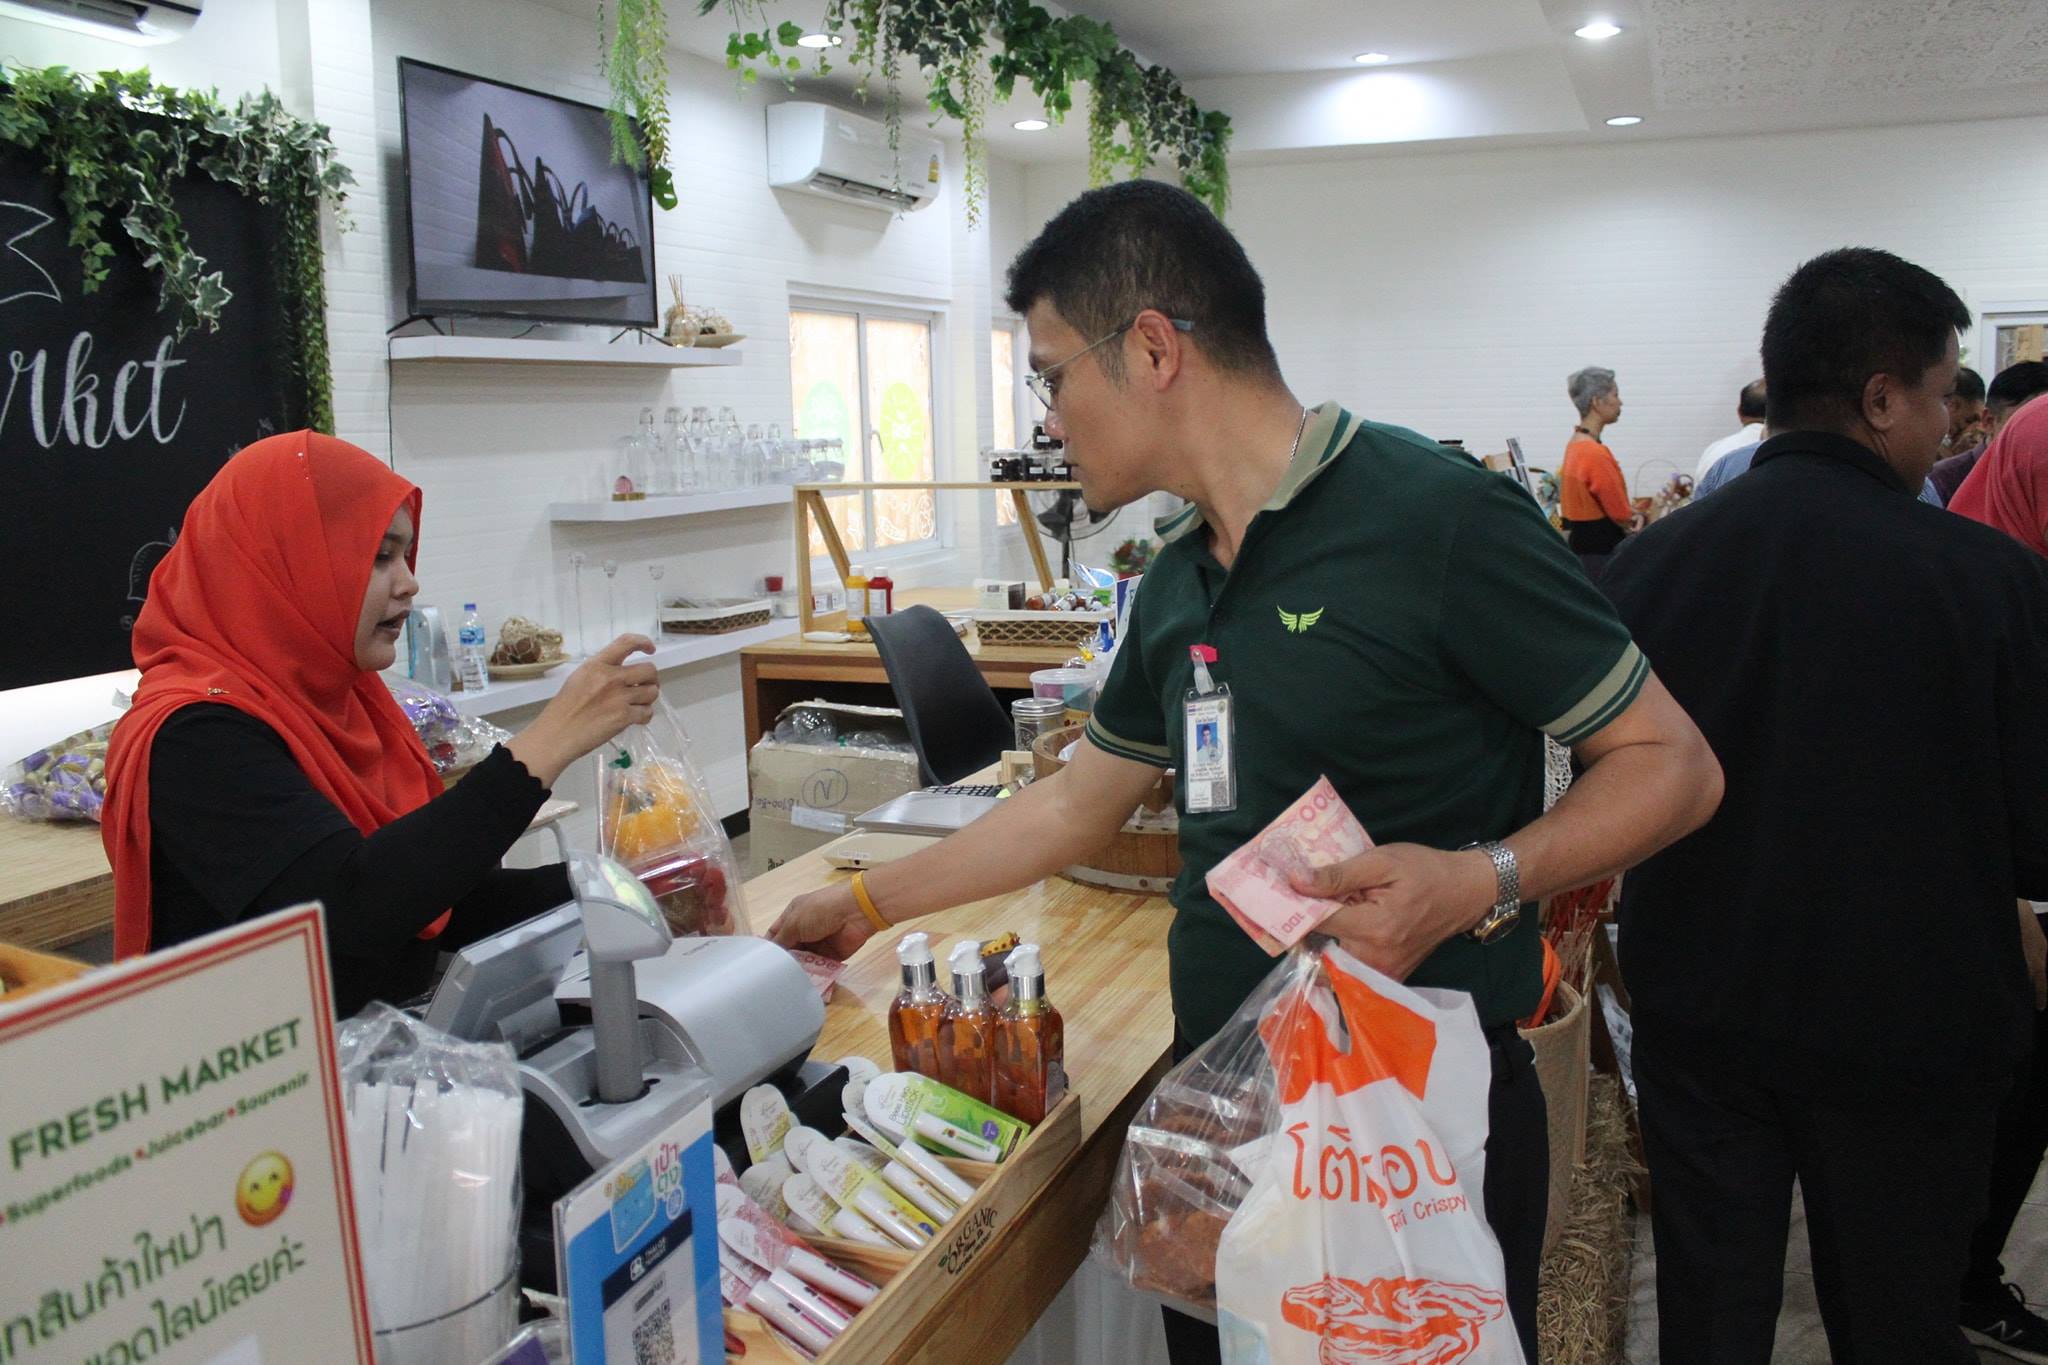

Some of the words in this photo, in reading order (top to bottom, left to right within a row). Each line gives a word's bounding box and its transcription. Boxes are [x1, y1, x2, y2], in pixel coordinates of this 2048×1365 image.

[8, 1083, 149, 1171] FRESH
[158, 1018, 302, 1104] MARKET
[1412, 1193, 1468, 1221] Crispy
